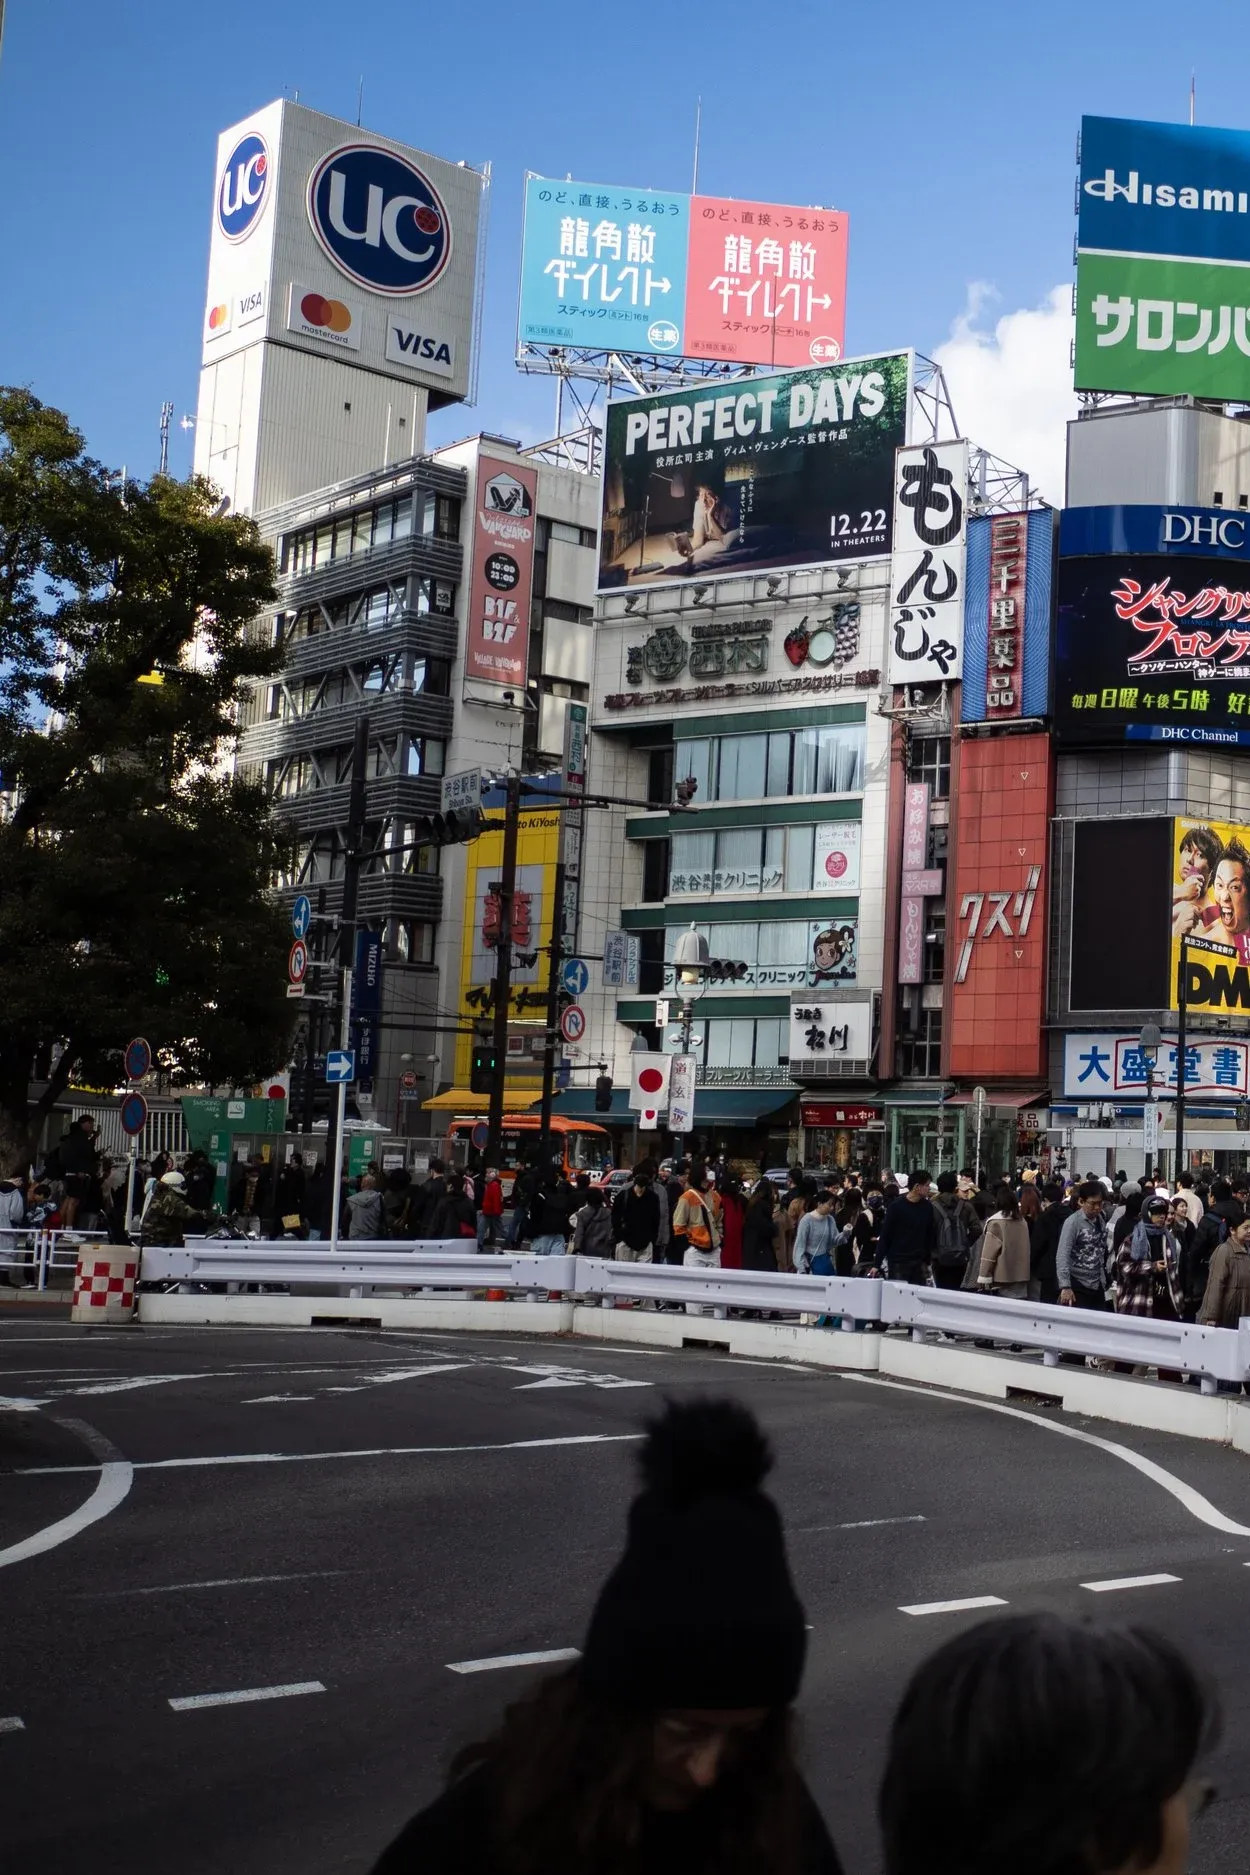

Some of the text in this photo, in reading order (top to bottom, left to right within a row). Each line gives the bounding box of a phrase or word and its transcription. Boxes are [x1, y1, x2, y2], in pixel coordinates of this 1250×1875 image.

[223, 153, 265, 217] UC
[329, 169, 436, 263] UC
[538, 189, 681, 216] のど、直接、うるおう
[702, 206, 839, 233] のど、直接、うるおう
[559, 215, 657, 264] 龍角散
[723, 233, 817, 281] 龍角散
[543, 258, 672, 306] ダイレクト
[240, 291, 262, 315] VISA
[557, 304, 608, 319] スティック
[707, 275, 832, 323] ダイレクト
[301, 324, 349, 344] mastercard
[526, 325, 573, 339] 第3類医薬品
[649, 327, 678, 344] 生薬
[721, 320, 770, 334] スティック
[392, 327, 451, 365] VISA
[810, 343, 840, 358] 生薬
[625, 371, 885, 456] PERFECT DAYS
[656, 428, 848, 469] 役所広司 主演 ヴィム・ヴェンダース監督作品
[830, 508, 887, 536] 12.22
[1163, 513, 1245, 548] DHC
[831, 534, 886, 547] IN THEATERS
[894, 447, 963, 675] もんじゃ
[484, 595, 517, 619] B1F
[987, 519, 1020, 707] 三千里薬品
[483, 619, 517, 644] B2F
[1072, 688, 1209, 711] 毎週日曜午後5時
[1162, 728, 1238, 743] DHC Channel
[529, 816, 560, 829] KiYosh
[908, 787, 924, 867] お好み焼
[954, 865, 1043, 983] クスリ
[367, 943, 378, 986] MIZUHO
[612, 935, 623, 983] 渋谷駅前
[805, 1024, 849, 1051] 松川
[706, 1069, 781, 1080] フルーツパーラー
